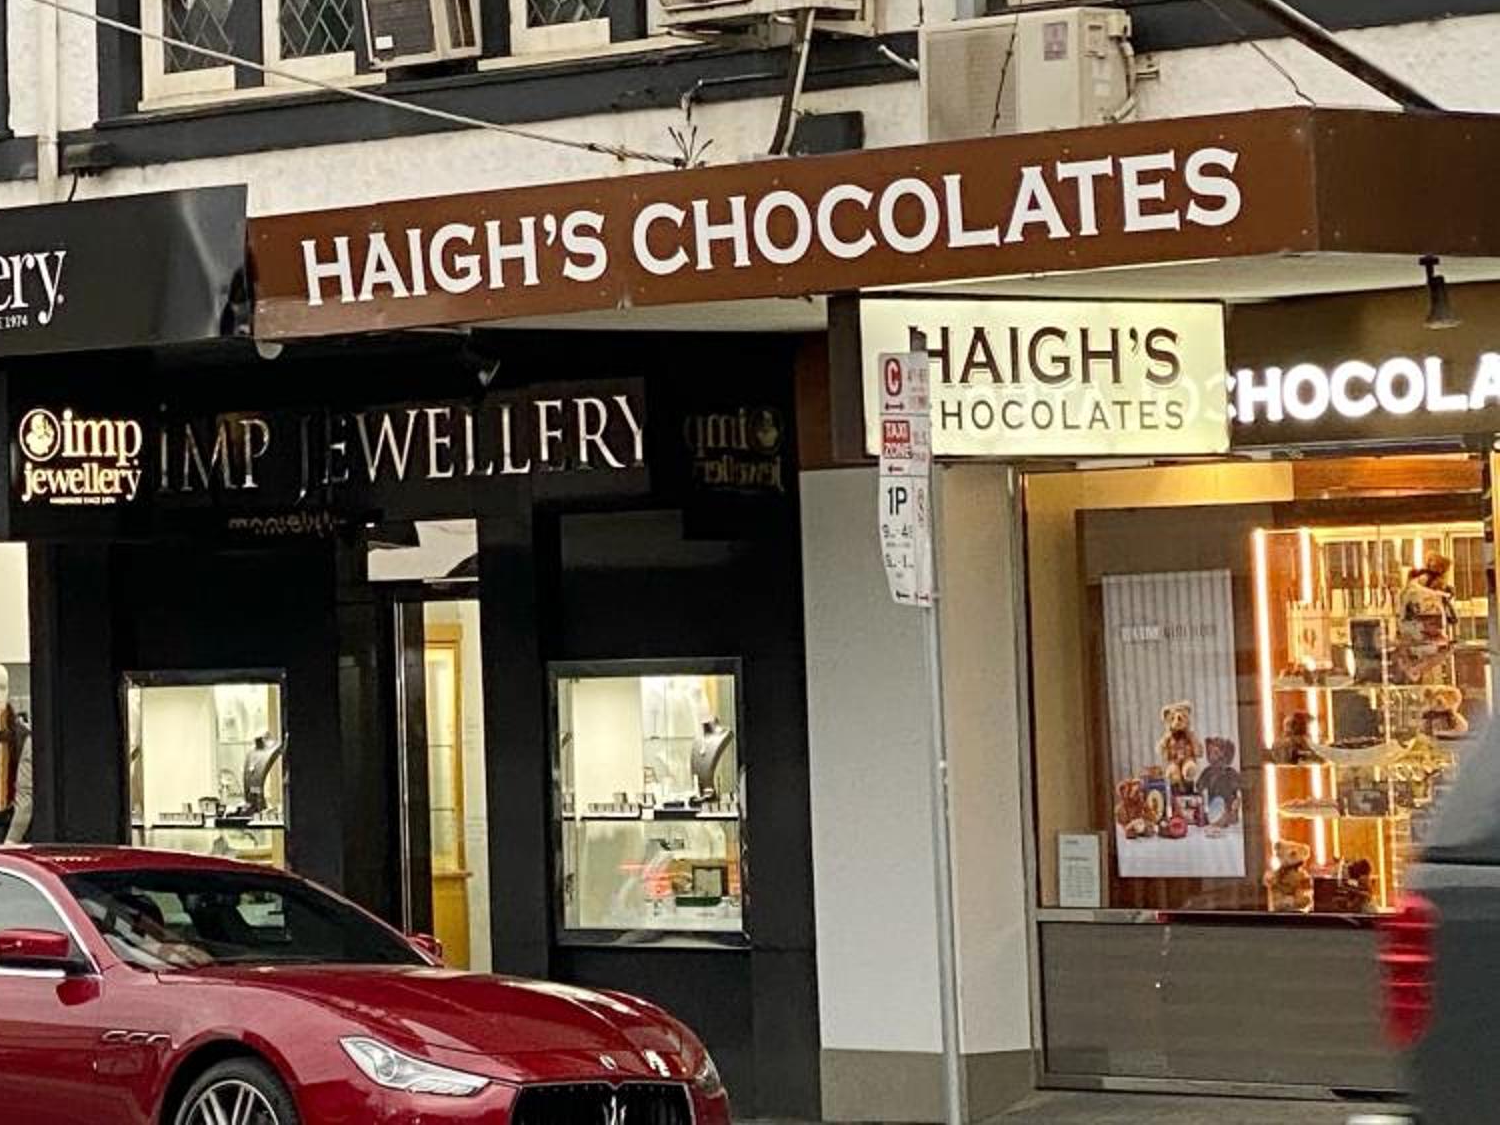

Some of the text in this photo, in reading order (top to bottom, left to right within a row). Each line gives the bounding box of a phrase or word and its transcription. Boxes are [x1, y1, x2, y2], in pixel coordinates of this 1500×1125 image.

[302, 148, 1241, 307] HAIGH'S CHOCOLATES
[5, 313, 29, 329] 1974
[941, 398, 1184, 431] HOCOLATES
[61, 408, 142, 466] imp
[22, 460, 142, 502] jewellery
[887, 487, 907, 515] 1P
